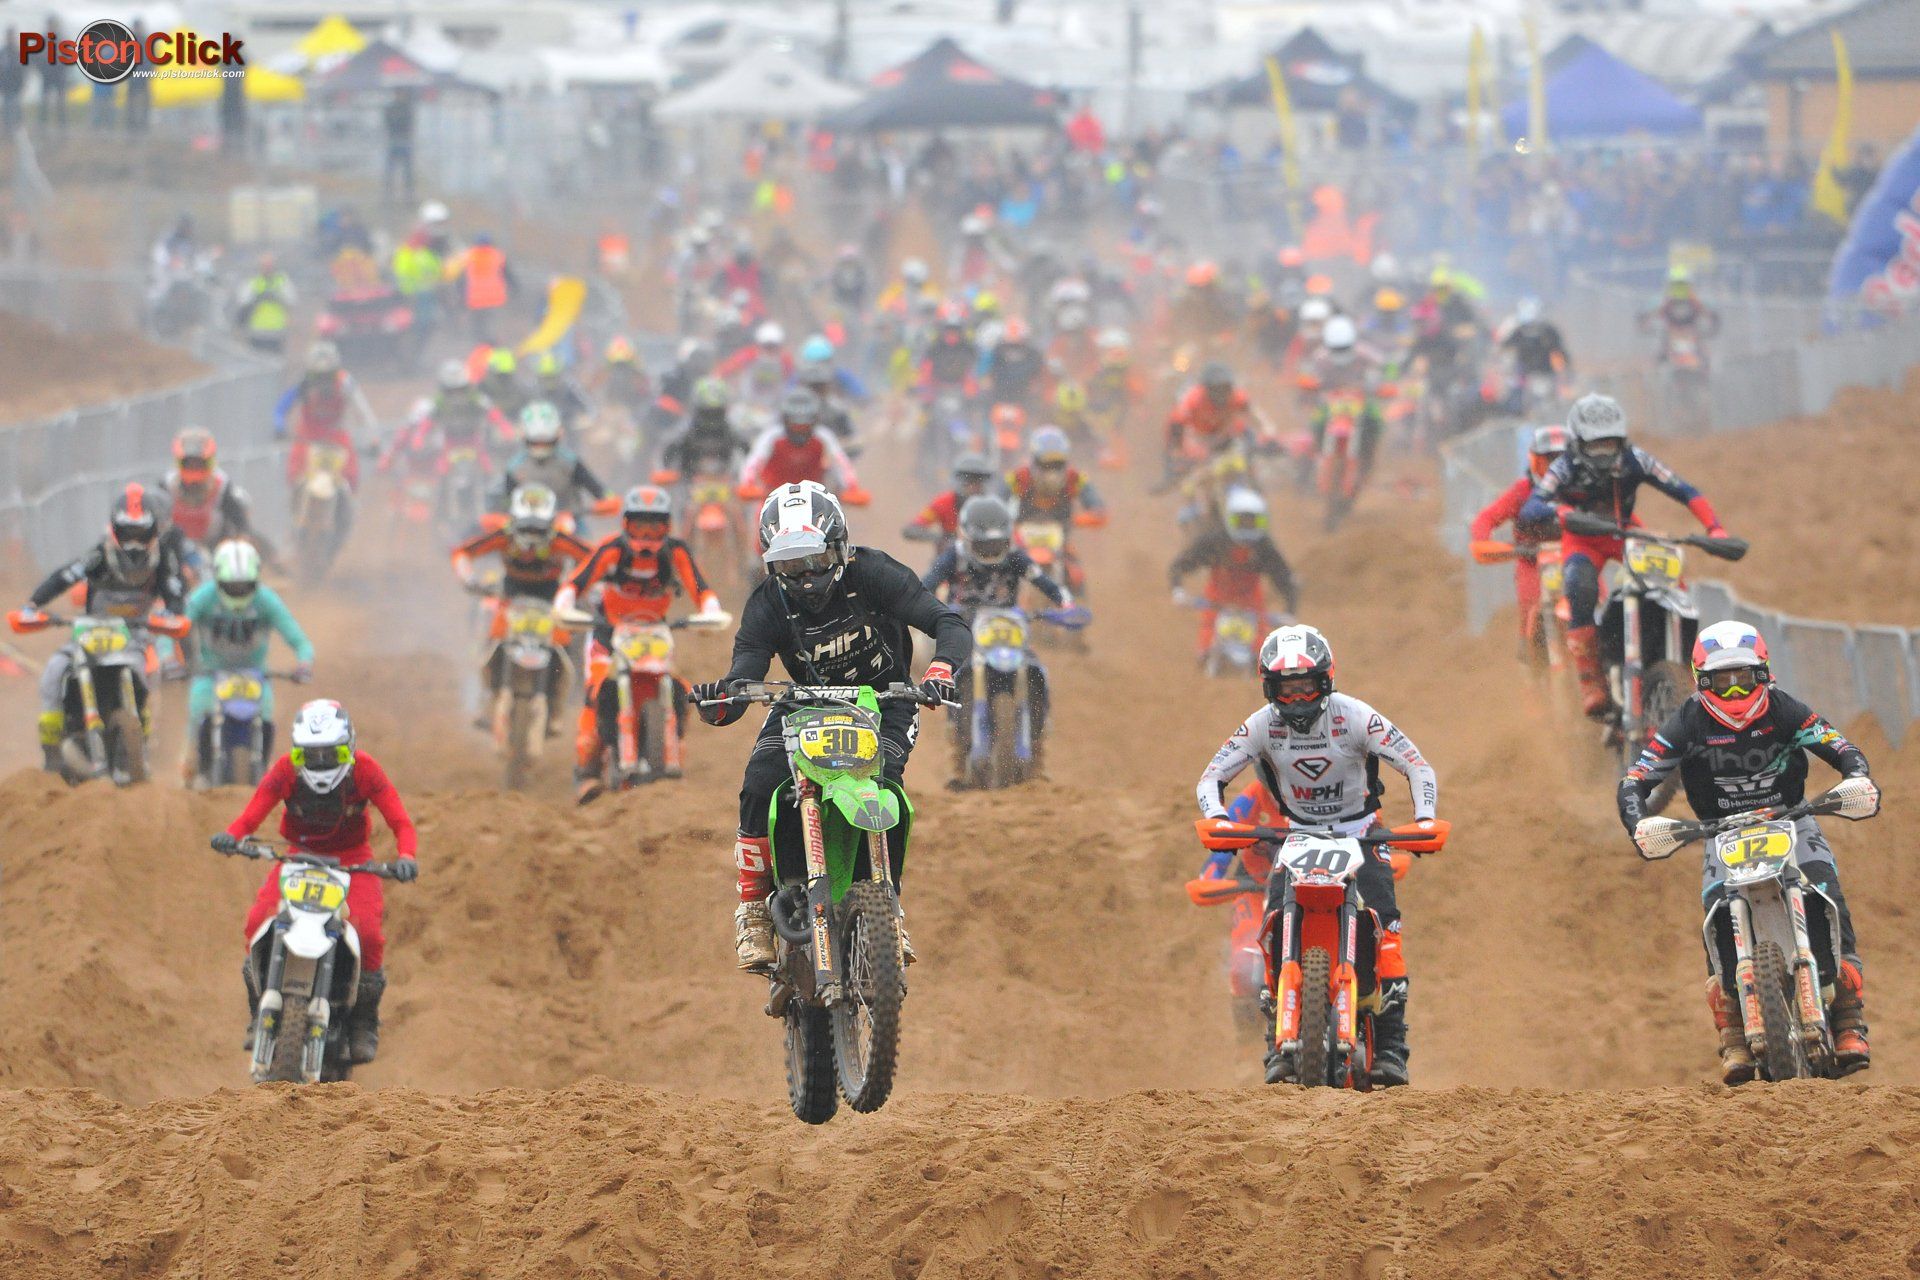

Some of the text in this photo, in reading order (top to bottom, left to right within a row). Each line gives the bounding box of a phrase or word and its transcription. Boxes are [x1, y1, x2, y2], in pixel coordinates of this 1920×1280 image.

[823, 729, 858, 755] 30
[1290, 782, 1342, 801] WPH
[1422, 780, 1434, 806] RIDE
[807, 807, 825, 866] SHOWA
[1744, 836, 1768, 859] 12
[1289, 848, 1352, 874] 40
